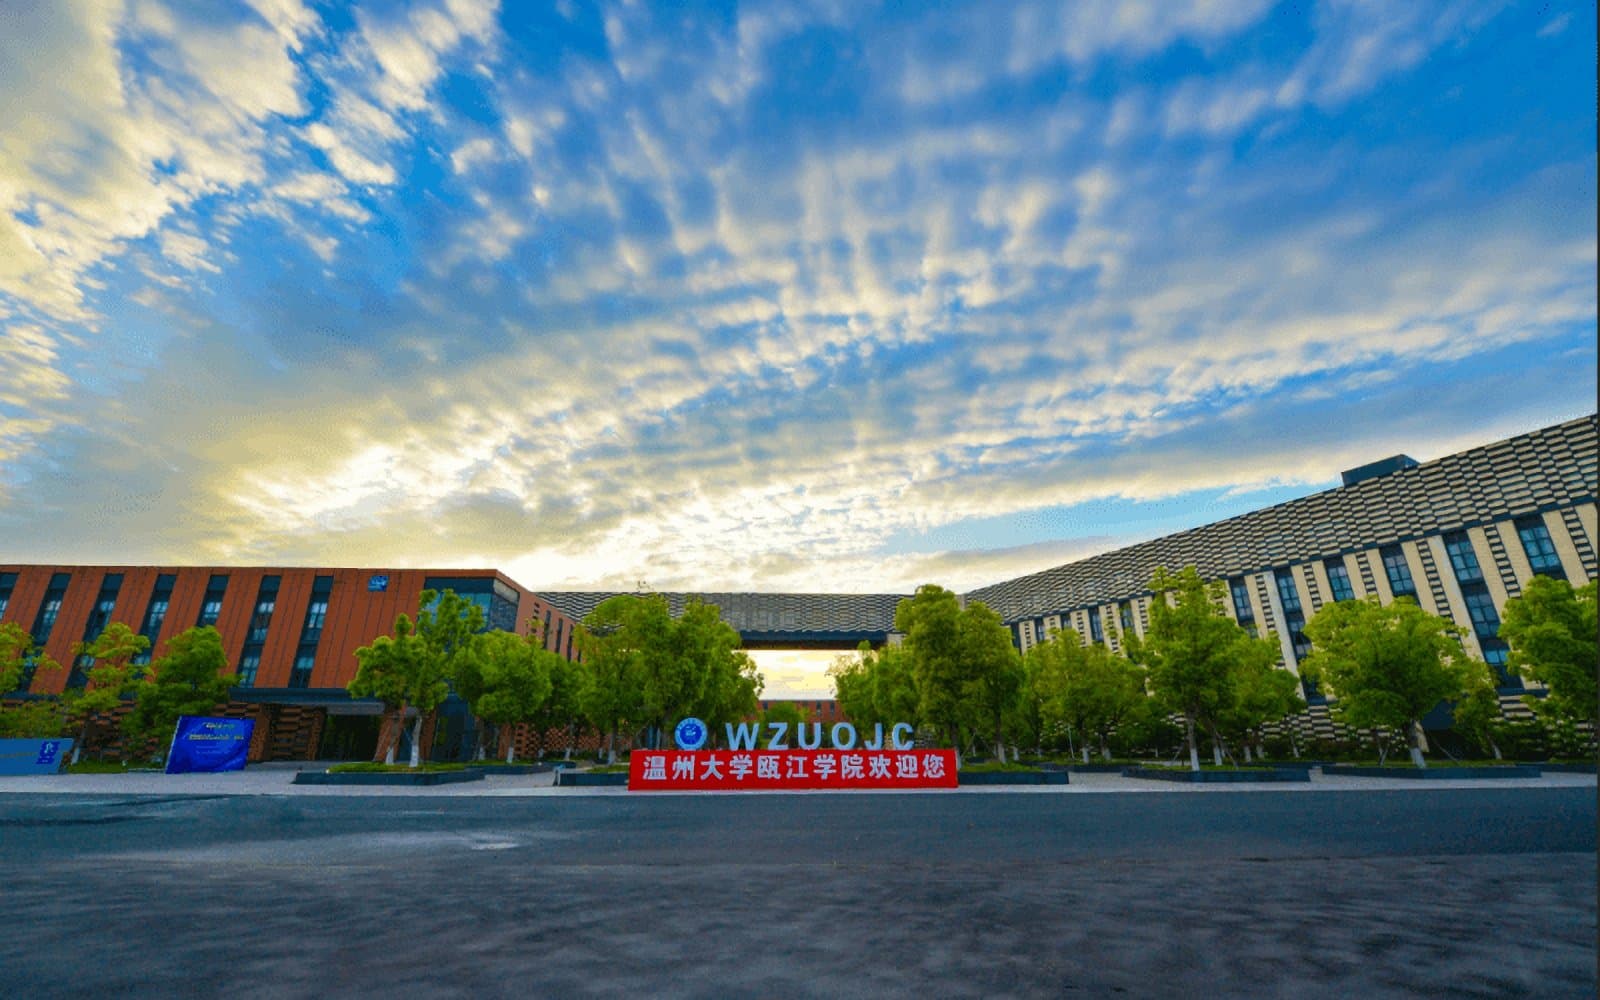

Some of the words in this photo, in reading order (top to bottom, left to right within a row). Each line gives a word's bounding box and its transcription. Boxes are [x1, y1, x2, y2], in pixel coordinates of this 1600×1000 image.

[725, 722, 915, 750] WZUOJC
[643, 754, 945, 780] 温州大学瓯江学院欢迎您
